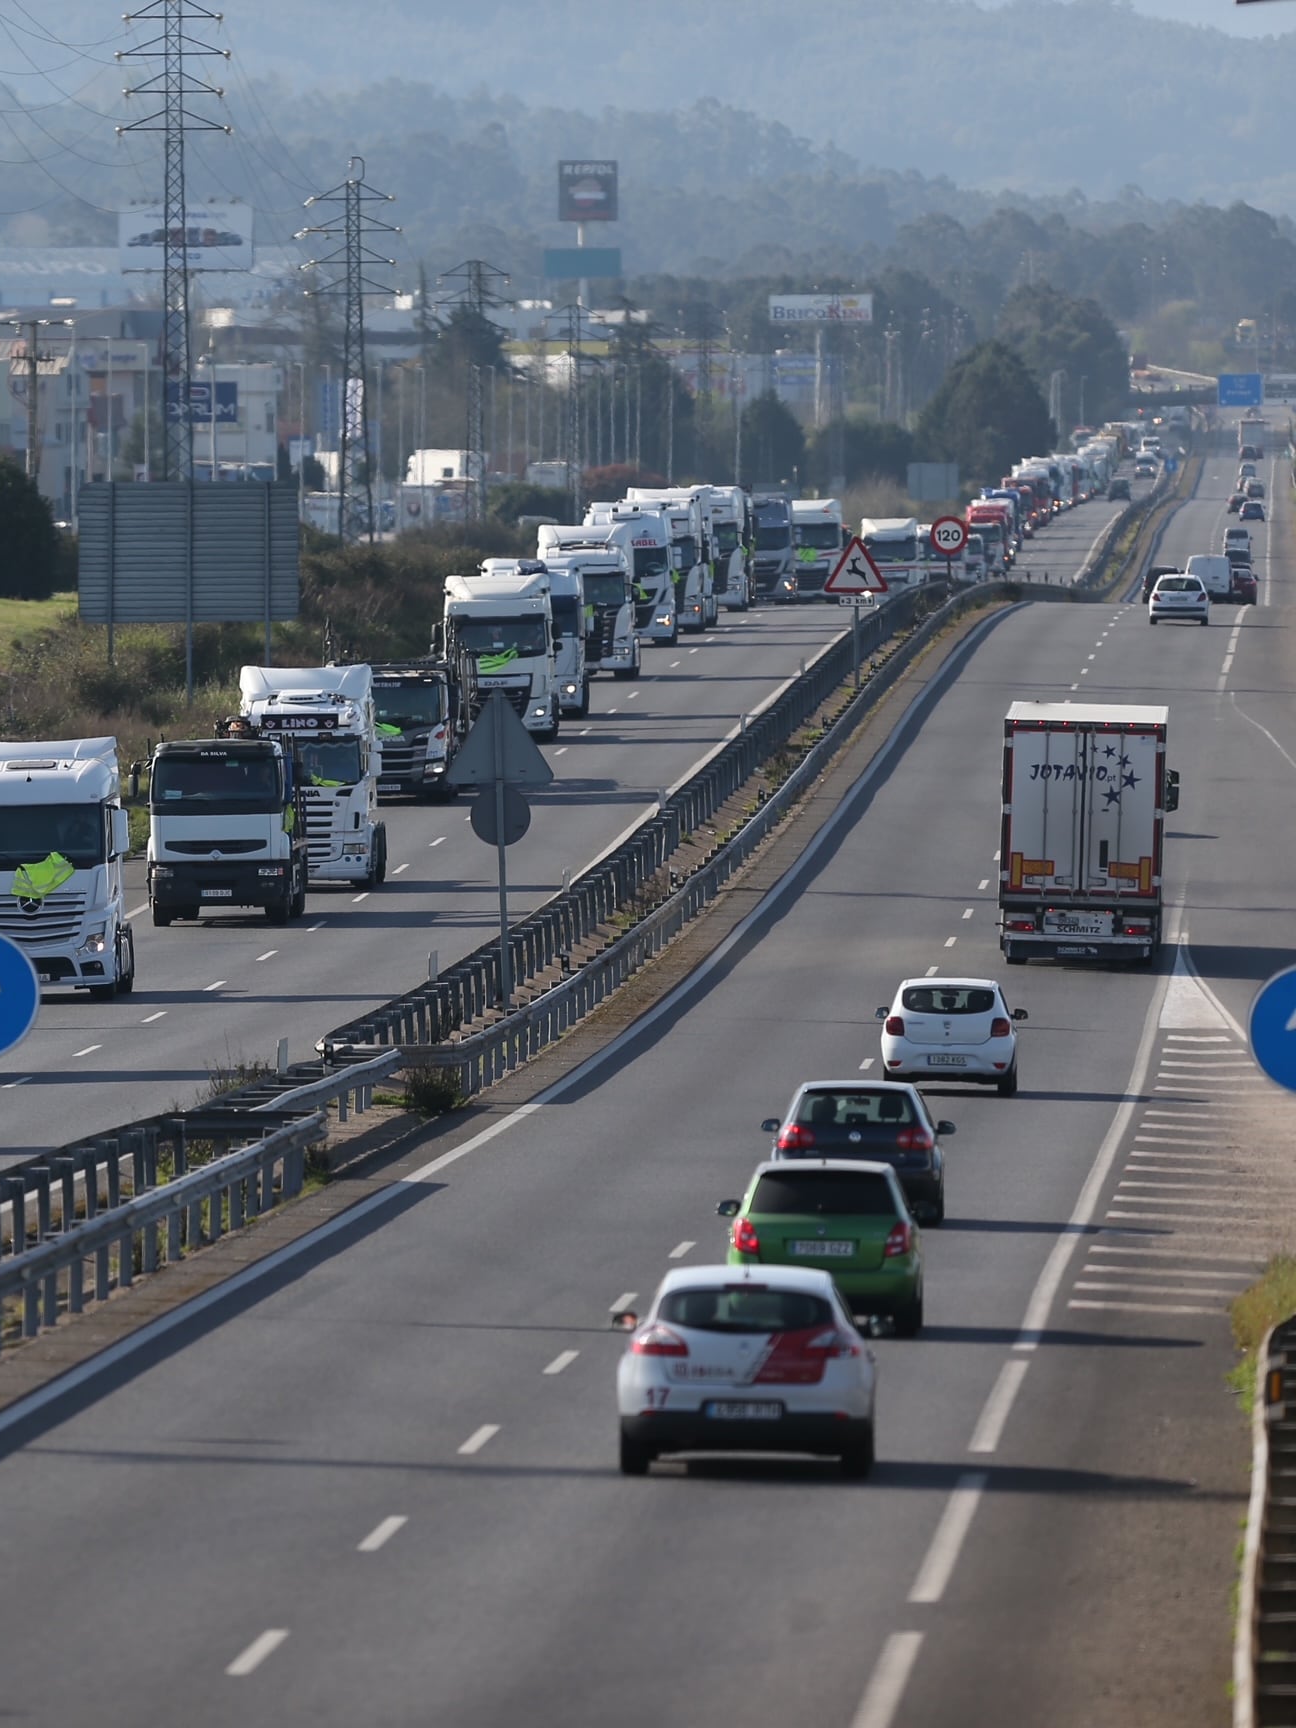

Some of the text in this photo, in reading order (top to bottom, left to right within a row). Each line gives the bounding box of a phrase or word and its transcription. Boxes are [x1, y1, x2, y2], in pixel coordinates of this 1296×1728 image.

[937, 530, 961, 542] 120
[855, 597, 867, 605] km
[1056, 924, 1102, 934] SCHMITZ
[646, 1386, 671, 1410] 17
